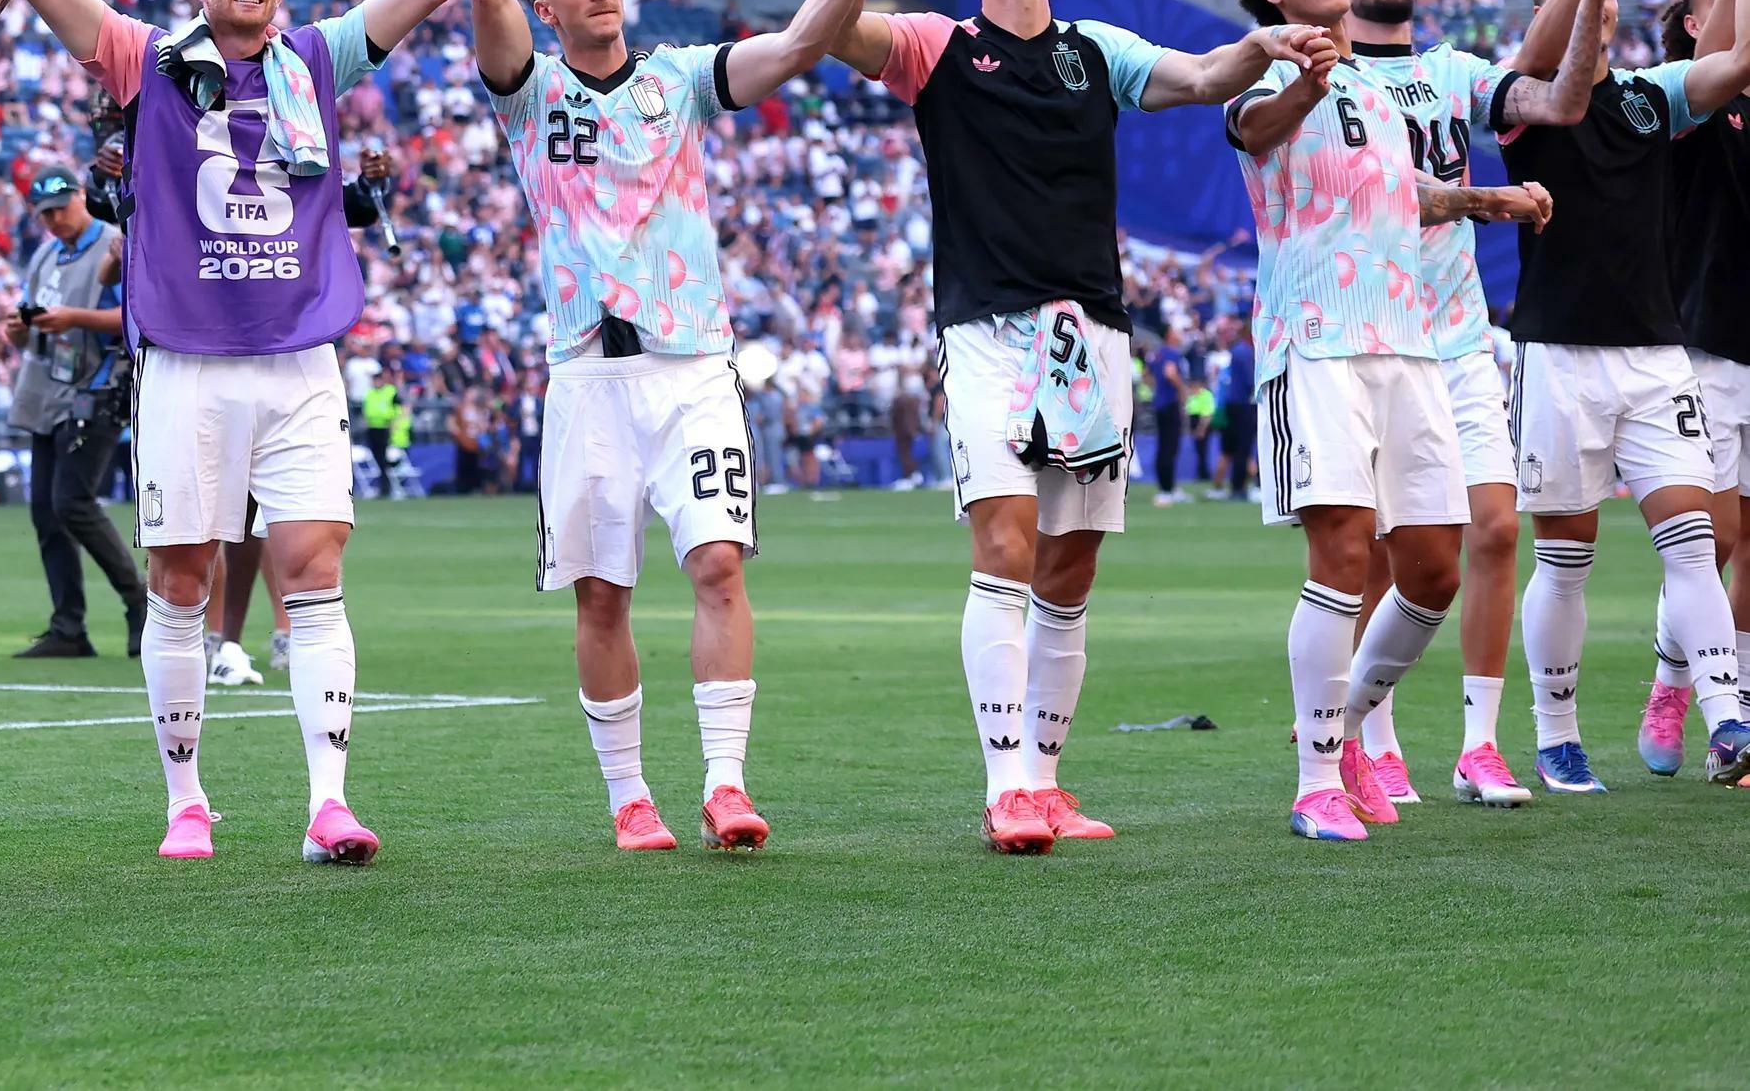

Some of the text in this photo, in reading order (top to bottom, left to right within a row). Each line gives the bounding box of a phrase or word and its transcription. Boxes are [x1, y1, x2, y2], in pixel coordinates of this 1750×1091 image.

[548, 110, 600, 166] 22
[1336, 97, 1368, 147] 6
[225, 202, 268, 221] FIFA
[199, 239, 299, 255] WORLD CUP
[199, 256, 301, 281] 2026
[691, 447, 748, 500] 22
